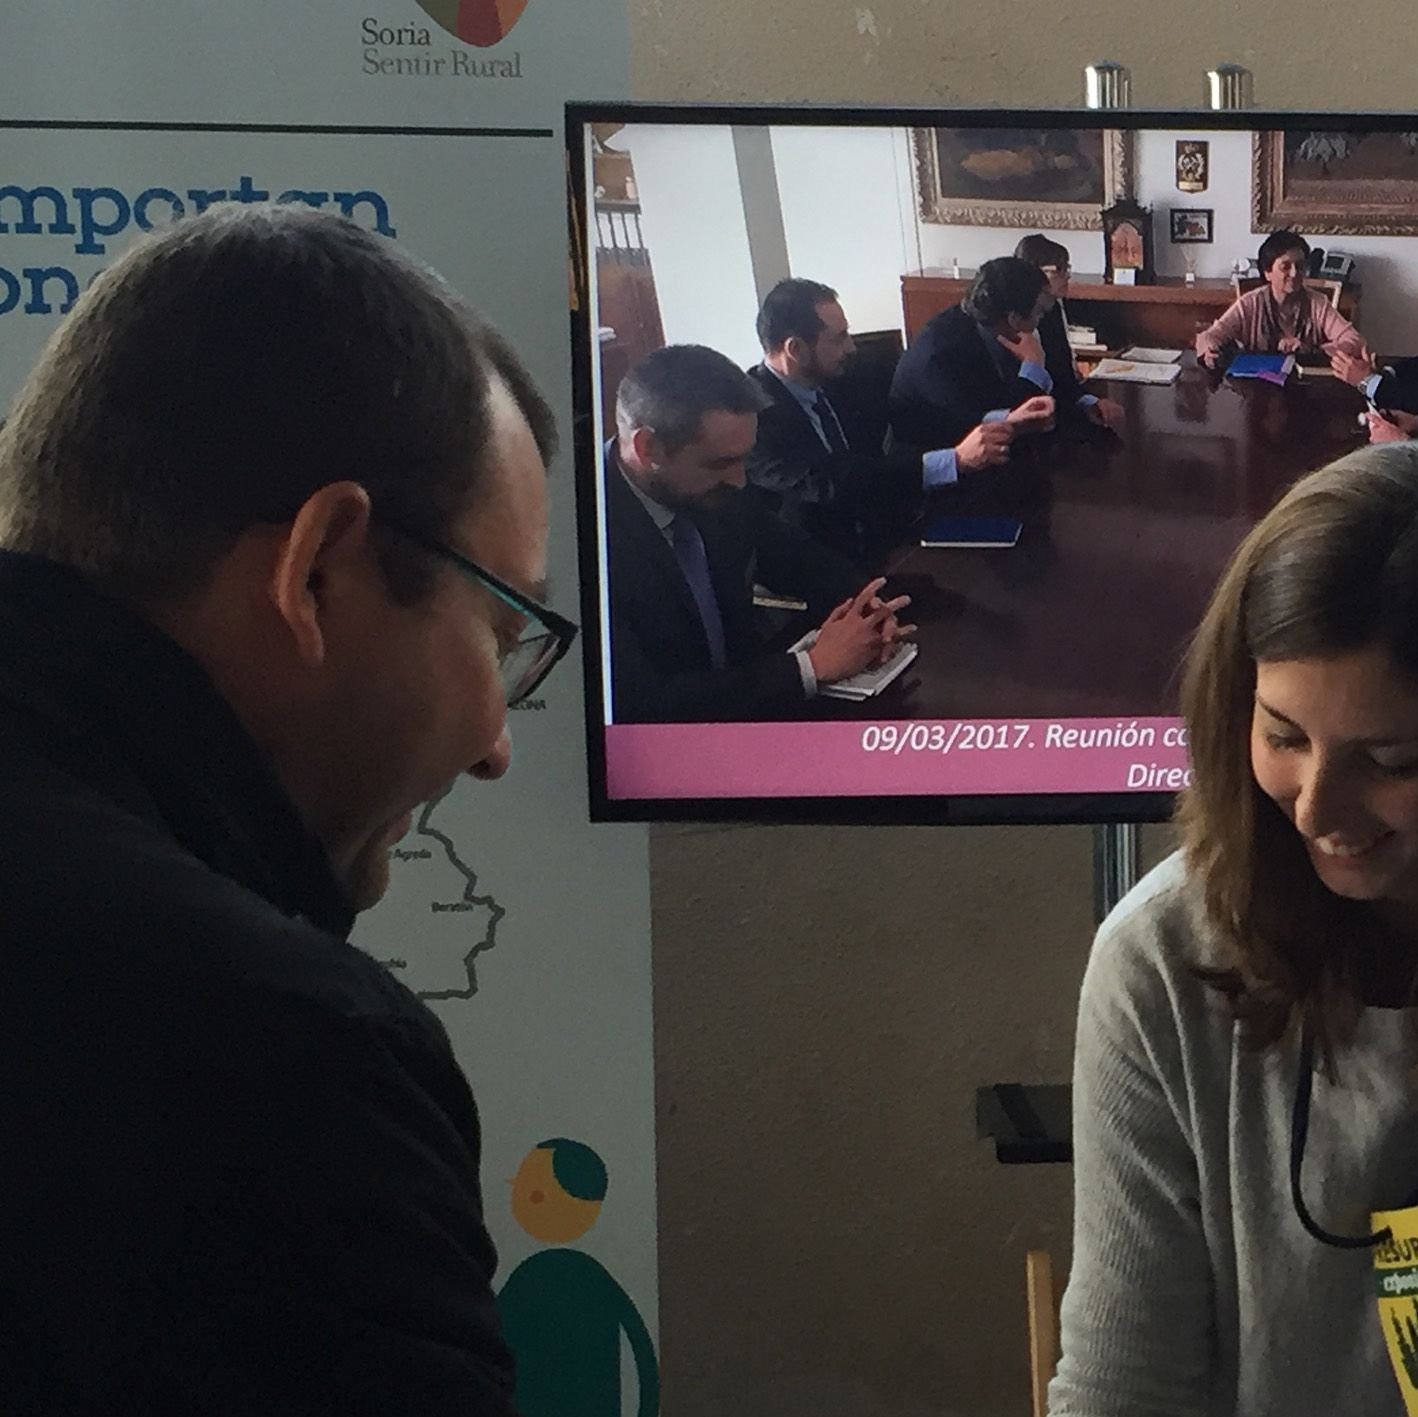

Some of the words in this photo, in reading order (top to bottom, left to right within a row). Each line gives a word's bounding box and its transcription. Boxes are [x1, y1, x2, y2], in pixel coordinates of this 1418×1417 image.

[361, 17, 431, 46] Soria
[362, 49, 446, 76] Sentir
[451, 50, 523, 78] Rural
[861, 722, 1035, 755] 09/03/2017.
[1044, 720, 1155, 749] Reunión
